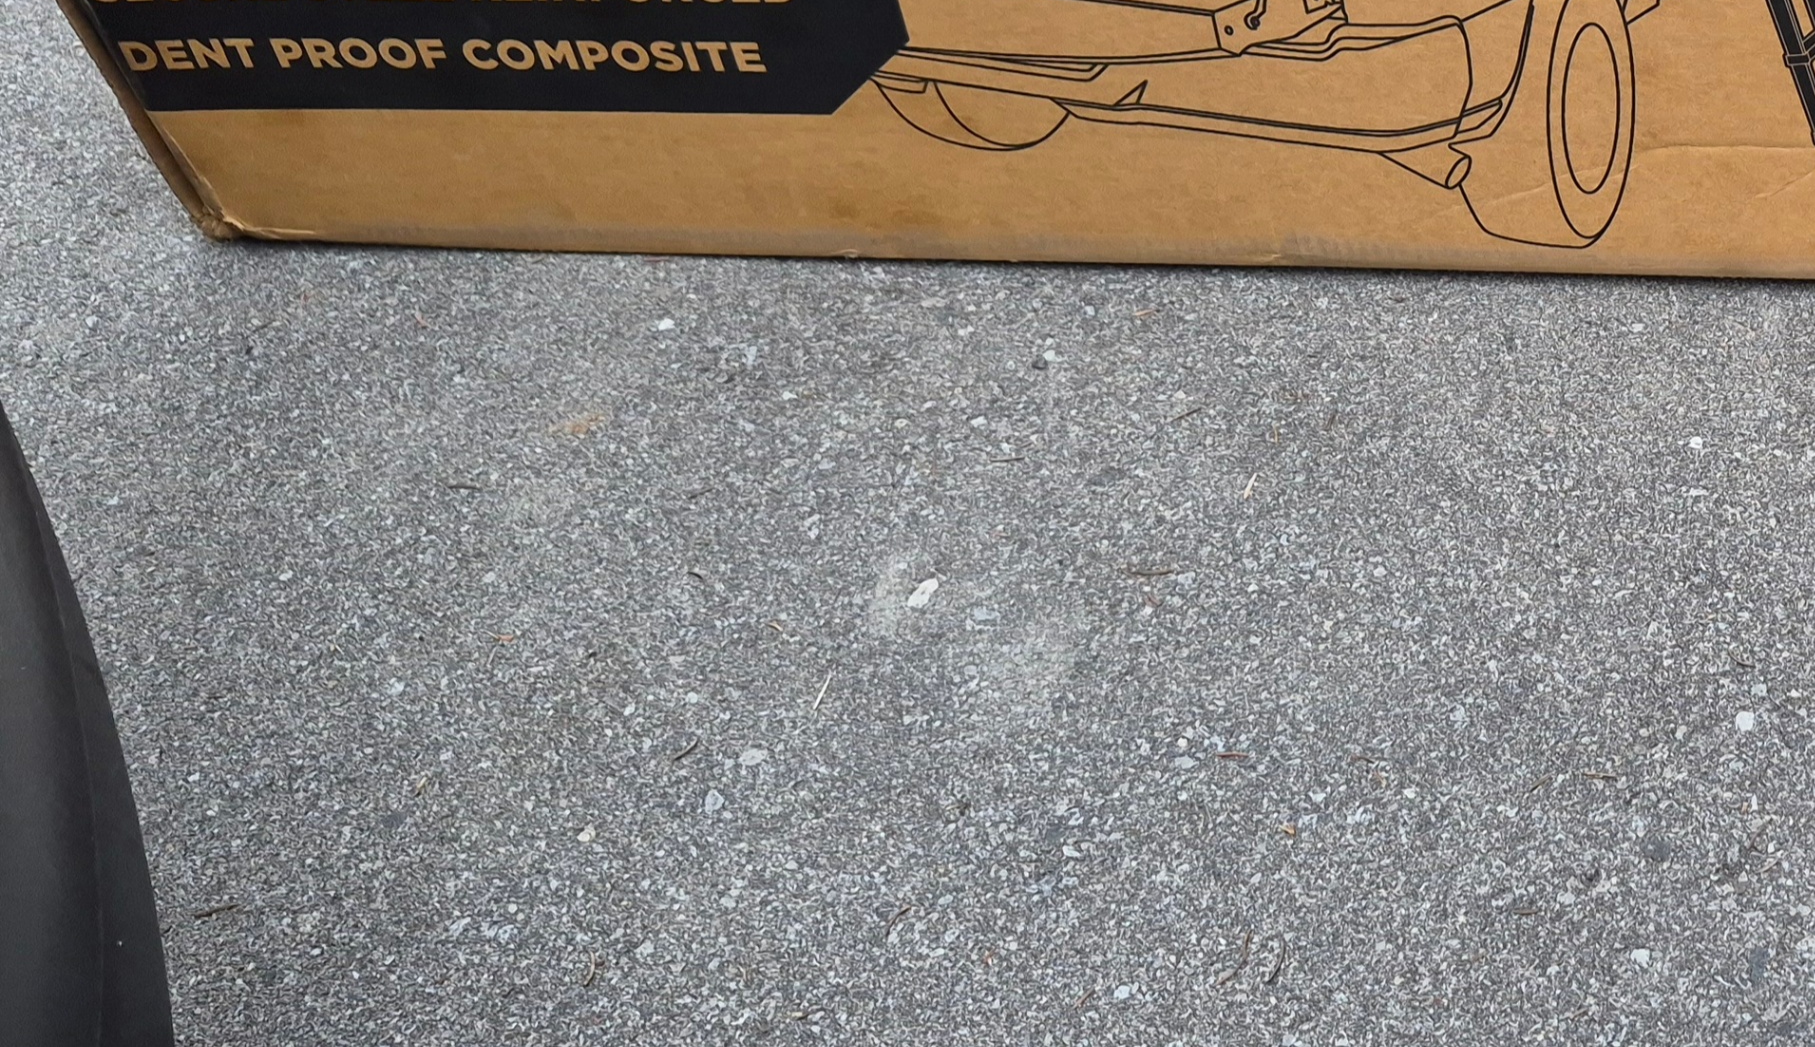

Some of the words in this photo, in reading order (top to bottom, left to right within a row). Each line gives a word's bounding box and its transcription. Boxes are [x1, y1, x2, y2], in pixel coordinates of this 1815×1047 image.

[117, 38, 254, 71] DENT
[269, 37, 446, 70] PROOF
[462, 38, 768, 72] COMPOSITE
